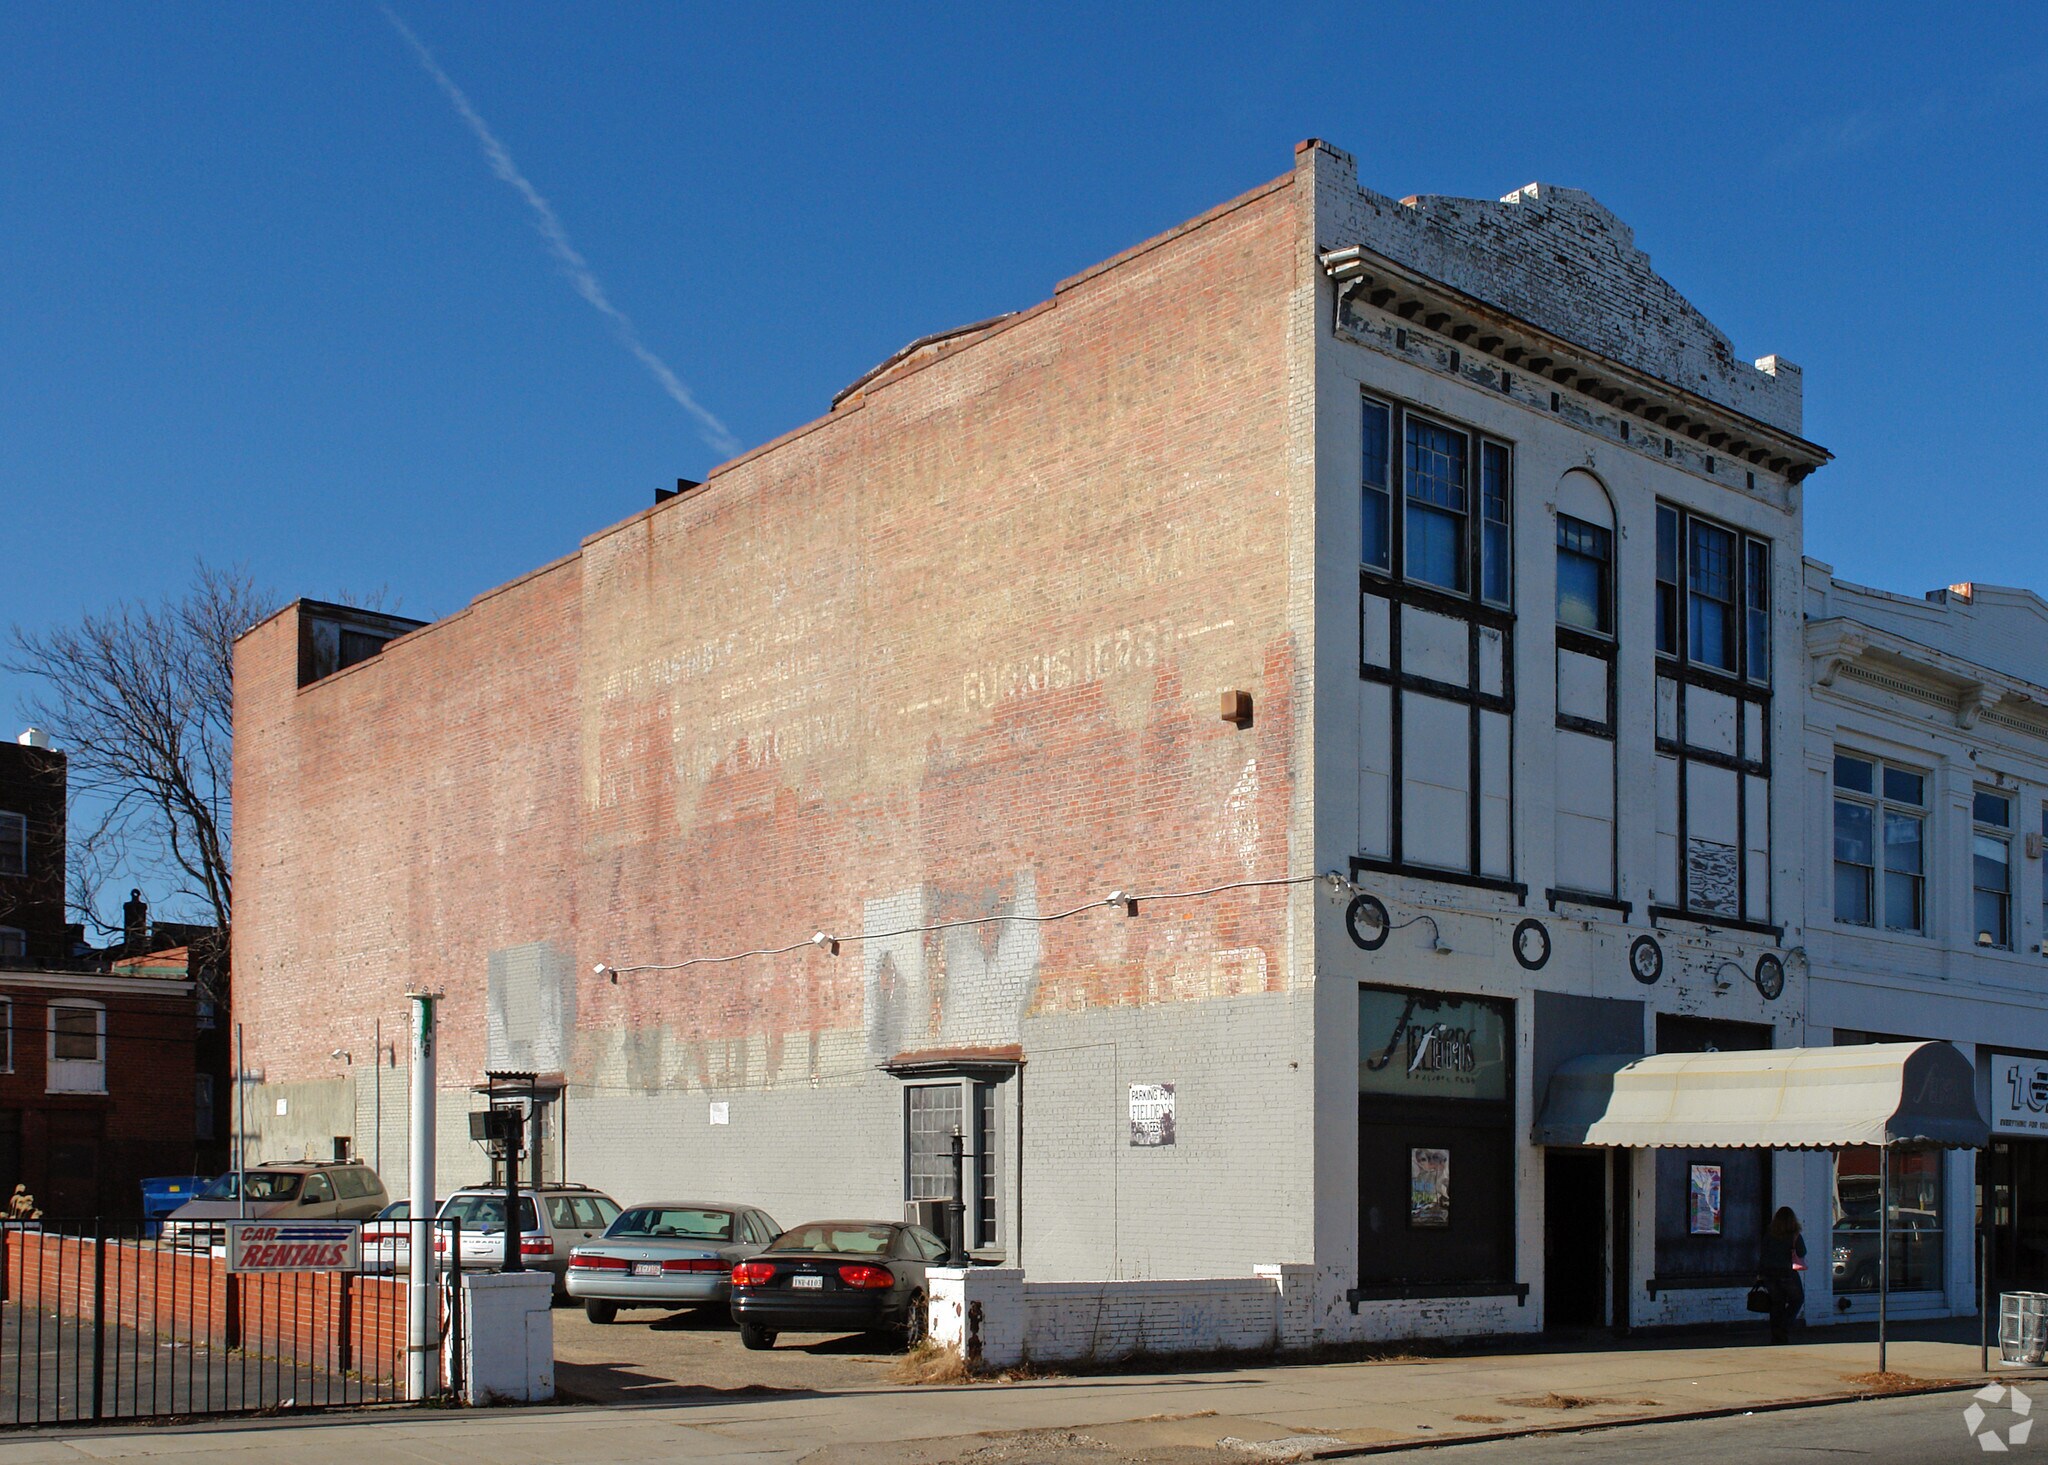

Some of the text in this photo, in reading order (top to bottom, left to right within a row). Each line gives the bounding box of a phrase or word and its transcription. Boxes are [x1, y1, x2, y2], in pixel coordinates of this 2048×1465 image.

[1131, 1087, 1173, 1101] PARKING FOR
[240, 1227, 278, 1241] CAR
[239, 1244, 348, 1267] RENTALS
